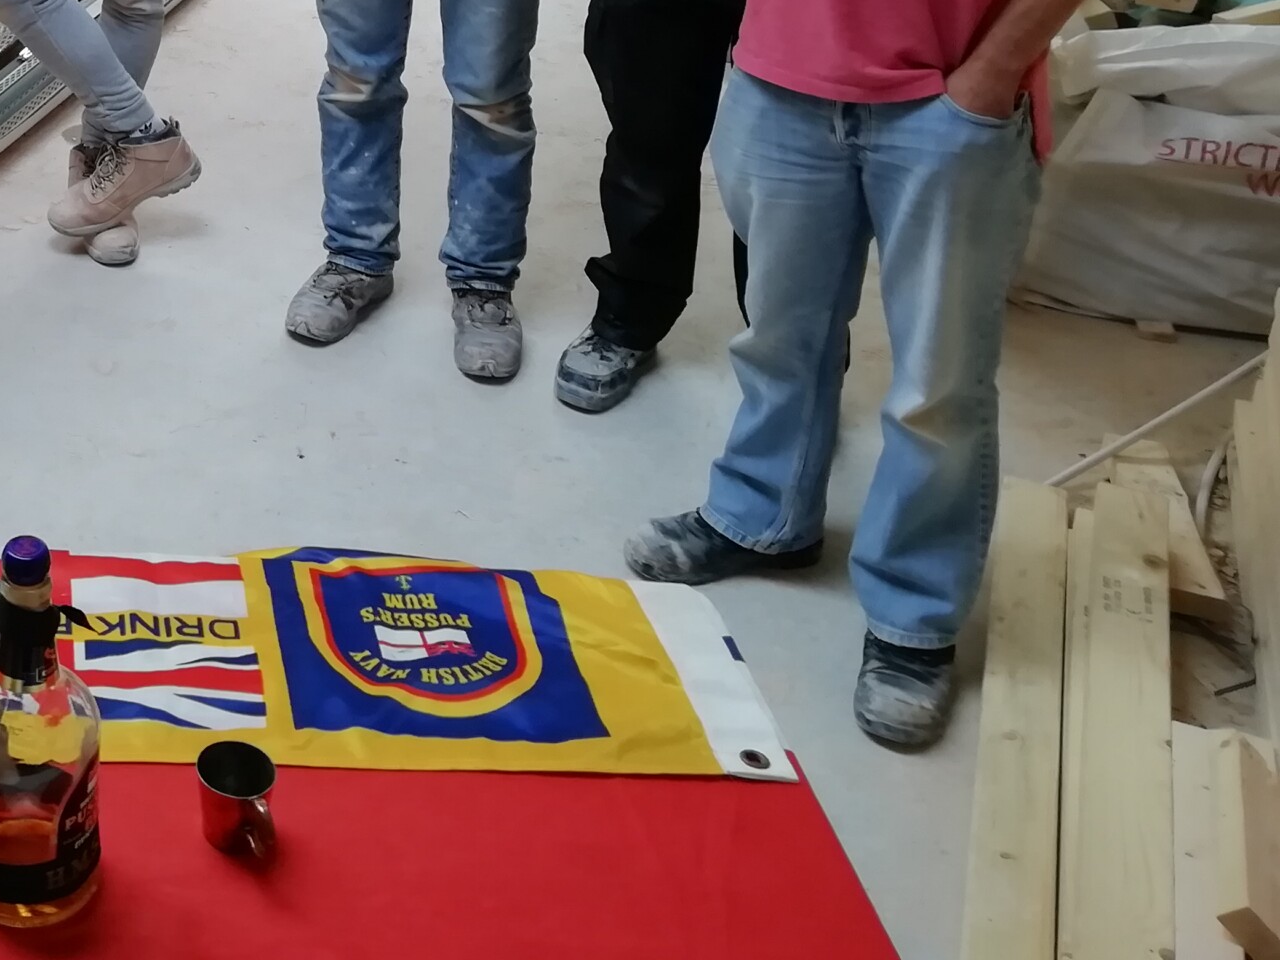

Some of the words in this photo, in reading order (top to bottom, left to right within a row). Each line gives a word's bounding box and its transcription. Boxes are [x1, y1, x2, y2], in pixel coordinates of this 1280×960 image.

[381, 593, 439, 610] RUM
[97, 614, 241, 640] DRINK
[359, 606, 473, 629] PUSSER'S
[349, 650, 412, 680] NAVY
[420, 651, 509, 685] BRITISH
